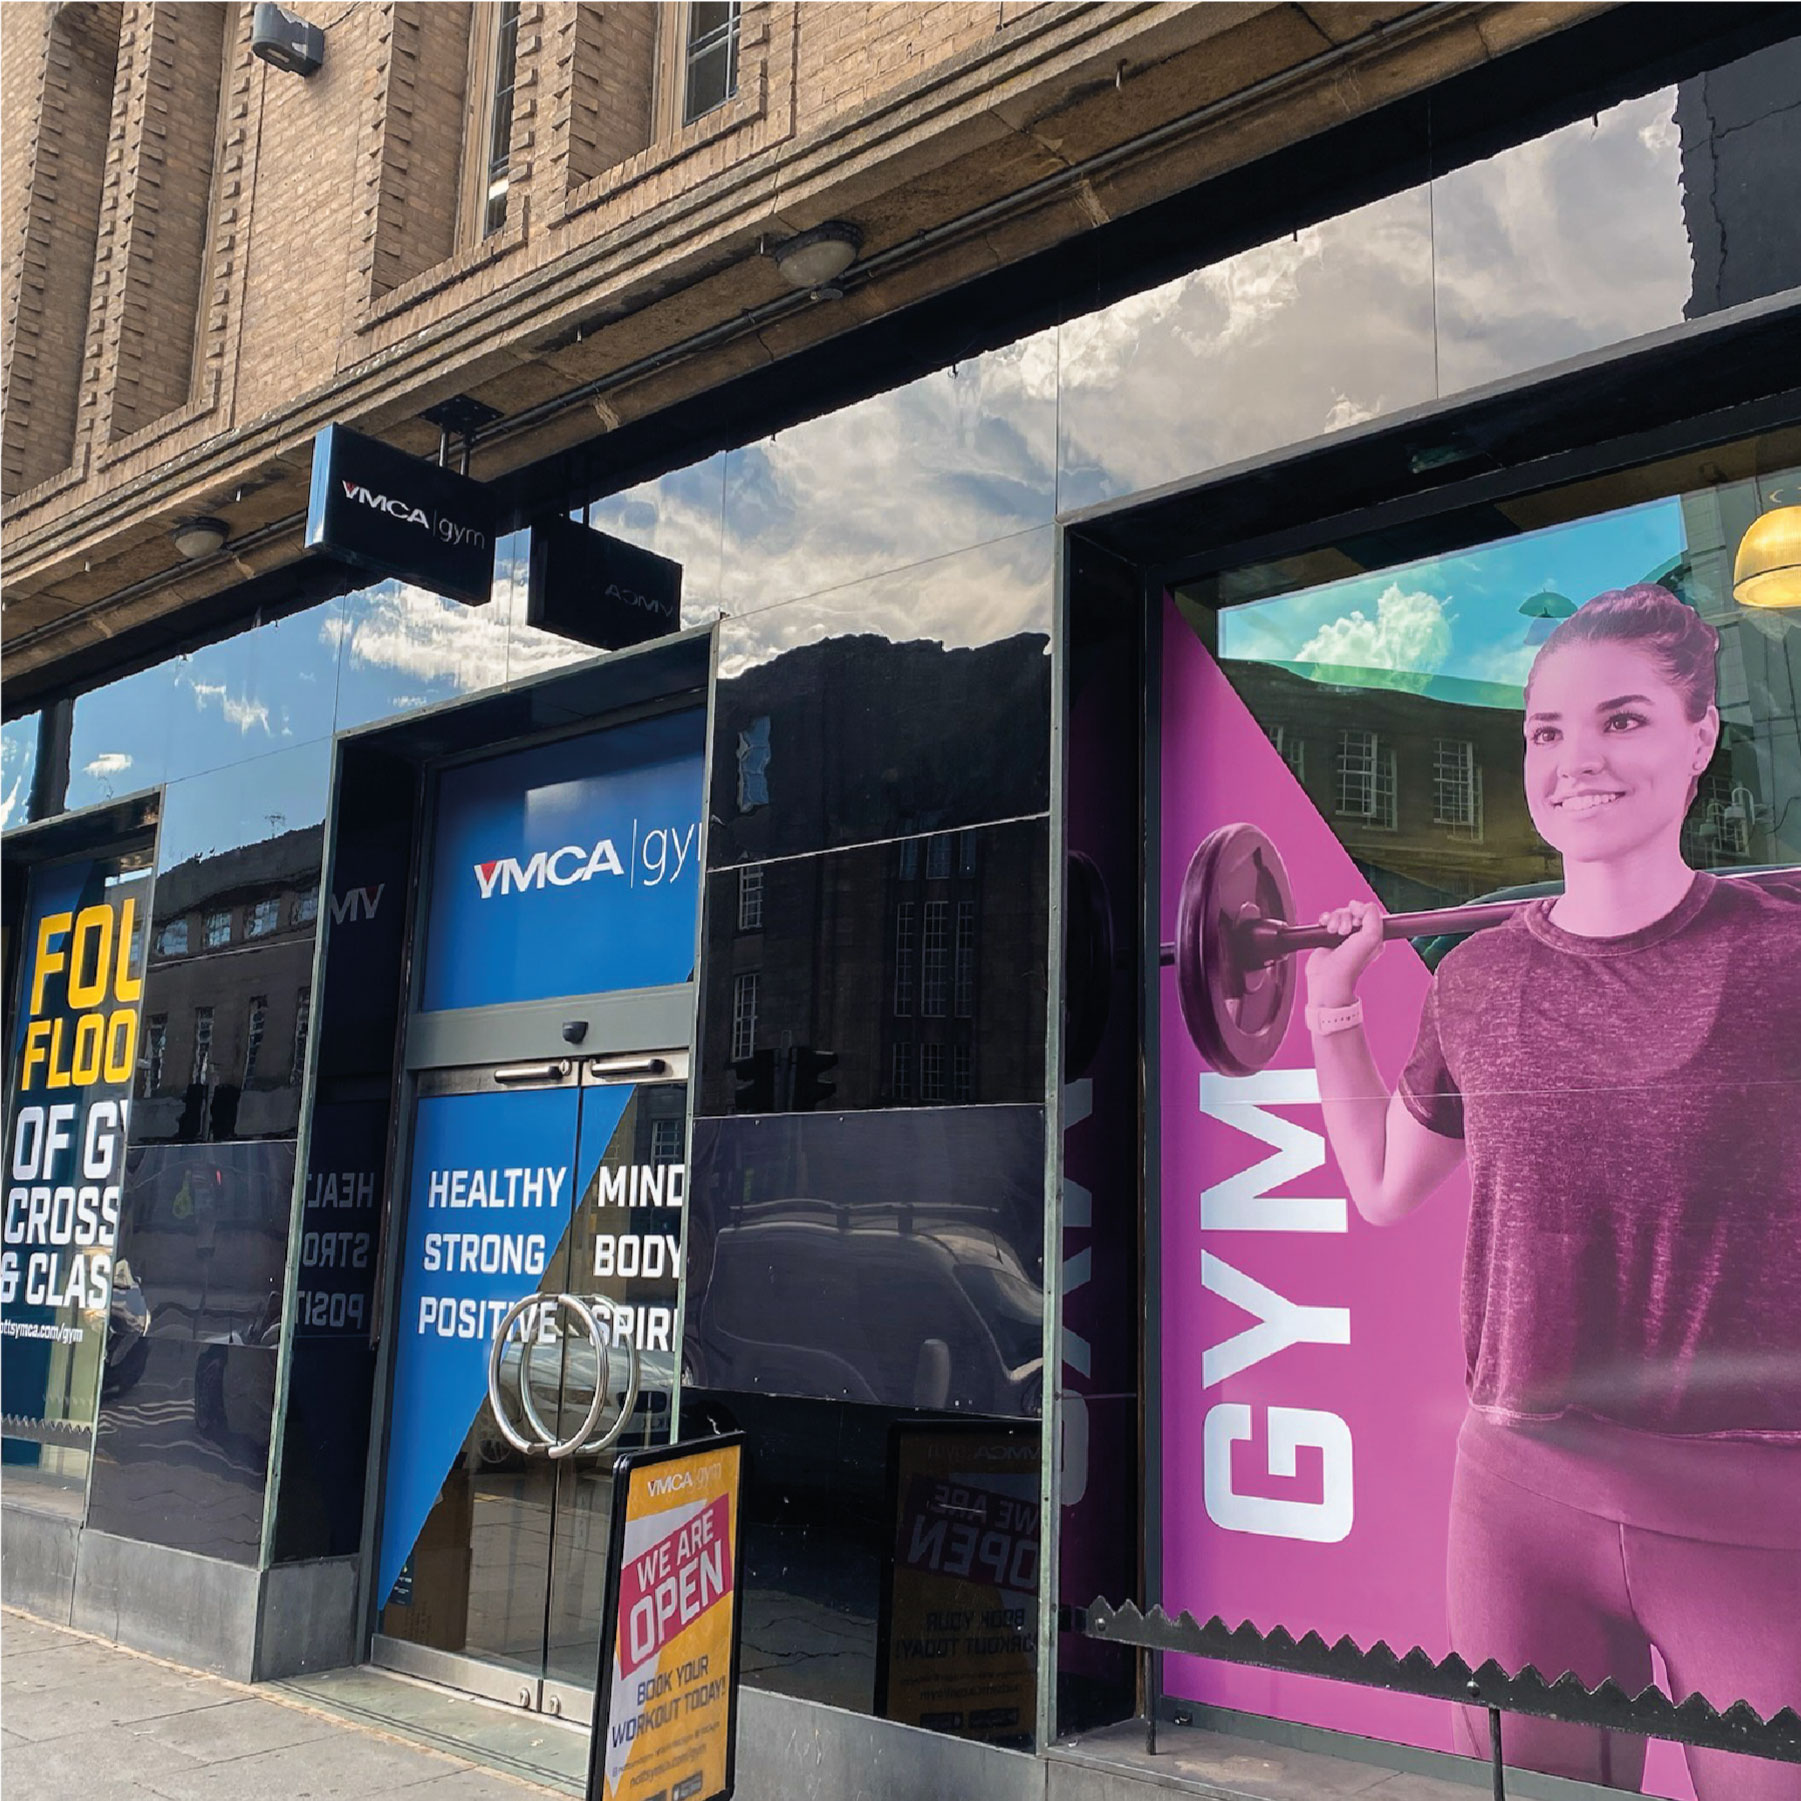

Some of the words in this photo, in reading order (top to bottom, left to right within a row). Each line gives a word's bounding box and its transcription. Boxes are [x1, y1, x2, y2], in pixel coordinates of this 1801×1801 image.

[341, 480, 430, 530] YMCA
[438, 517, 486, 549] gym
[474, 839, 624, 899] YMCA
[21, 1008, 137, 1091] FLOO
[13, 1104, 76, 1180] OF
[4, 1186, 120, 1245] CROSS
[428, 1167, 567, 1208] HEALTHY
[598, 1164, 685, 1207] MIND
[0, 1252, 19, 1303] &
[26, 1252, 111, 1309] CLAS
[423, 1233, 546, 1275] STRONG
[593, 1234, 682, 1279] BODY
[418, 1296, 558, 1343] POSITIVE
[1199, 1068, 1354, 1544] GYM
[647, 1471, 693, 1497] YMCA
[637, 1541, 671, 1593] WE
[677, 1509, 713, 1566] ARE
[630, 1539, 724, 1664] OPEN
[637, 1669, 673, 1706] BOOK
[676, 1654, 709, 1688] YOUR
[612, 1697, 682, 1748] WORKOUT
[685, 1675, 726, 1715] TODAY!
